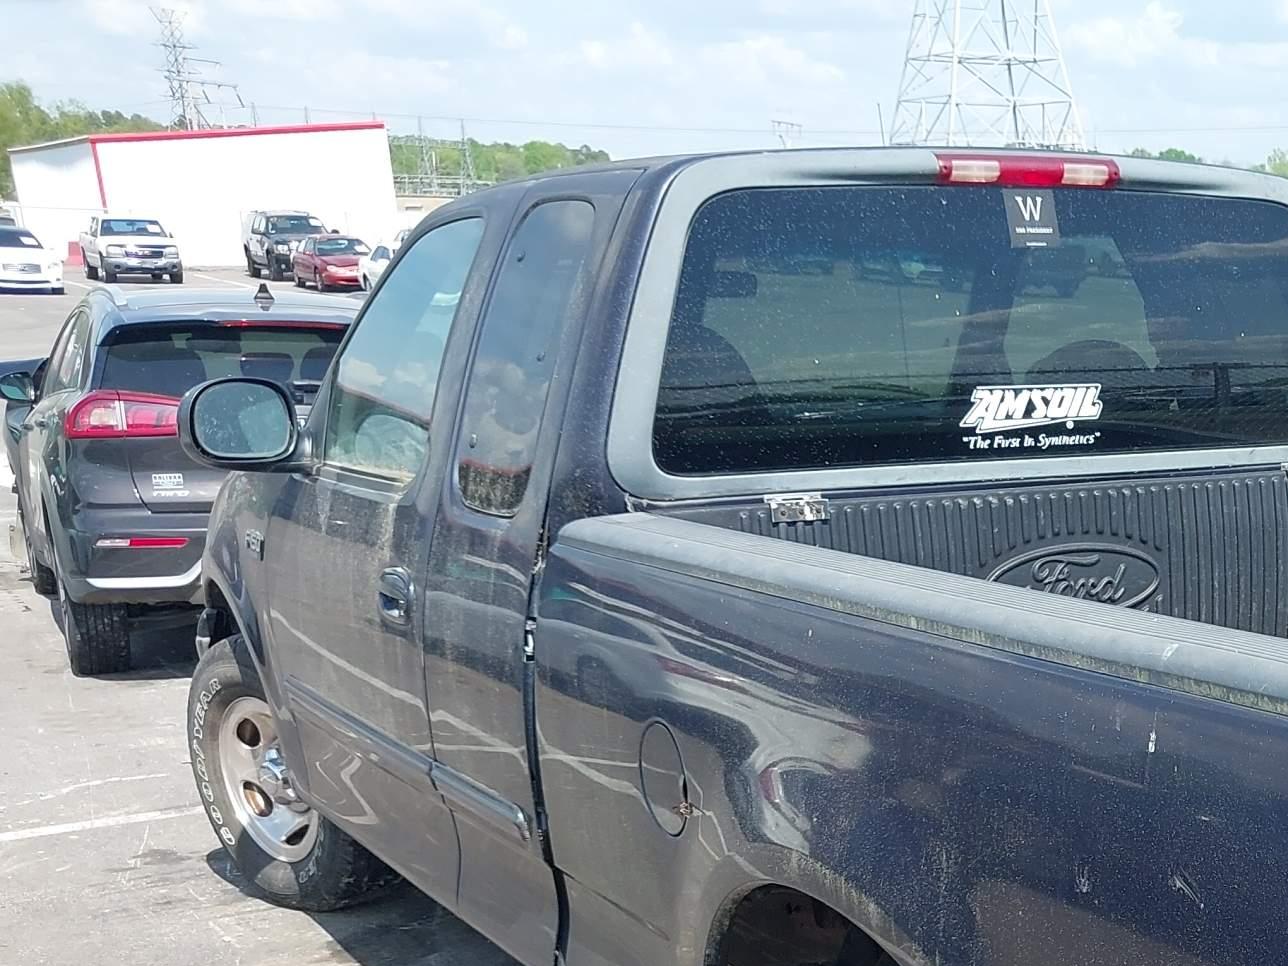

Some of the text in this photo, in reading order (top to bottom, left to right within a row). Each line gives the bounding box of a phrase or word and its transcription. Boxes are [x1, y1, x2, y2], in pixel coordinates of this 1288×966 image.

[1014, 196, 1043, 221] W
[960, 384, 1103, 433] AMSOIL
[993, 435, 1021, 449] First
[1023, 435, 1035, 447] In
[1031, 554, 1127, 600] Ford
